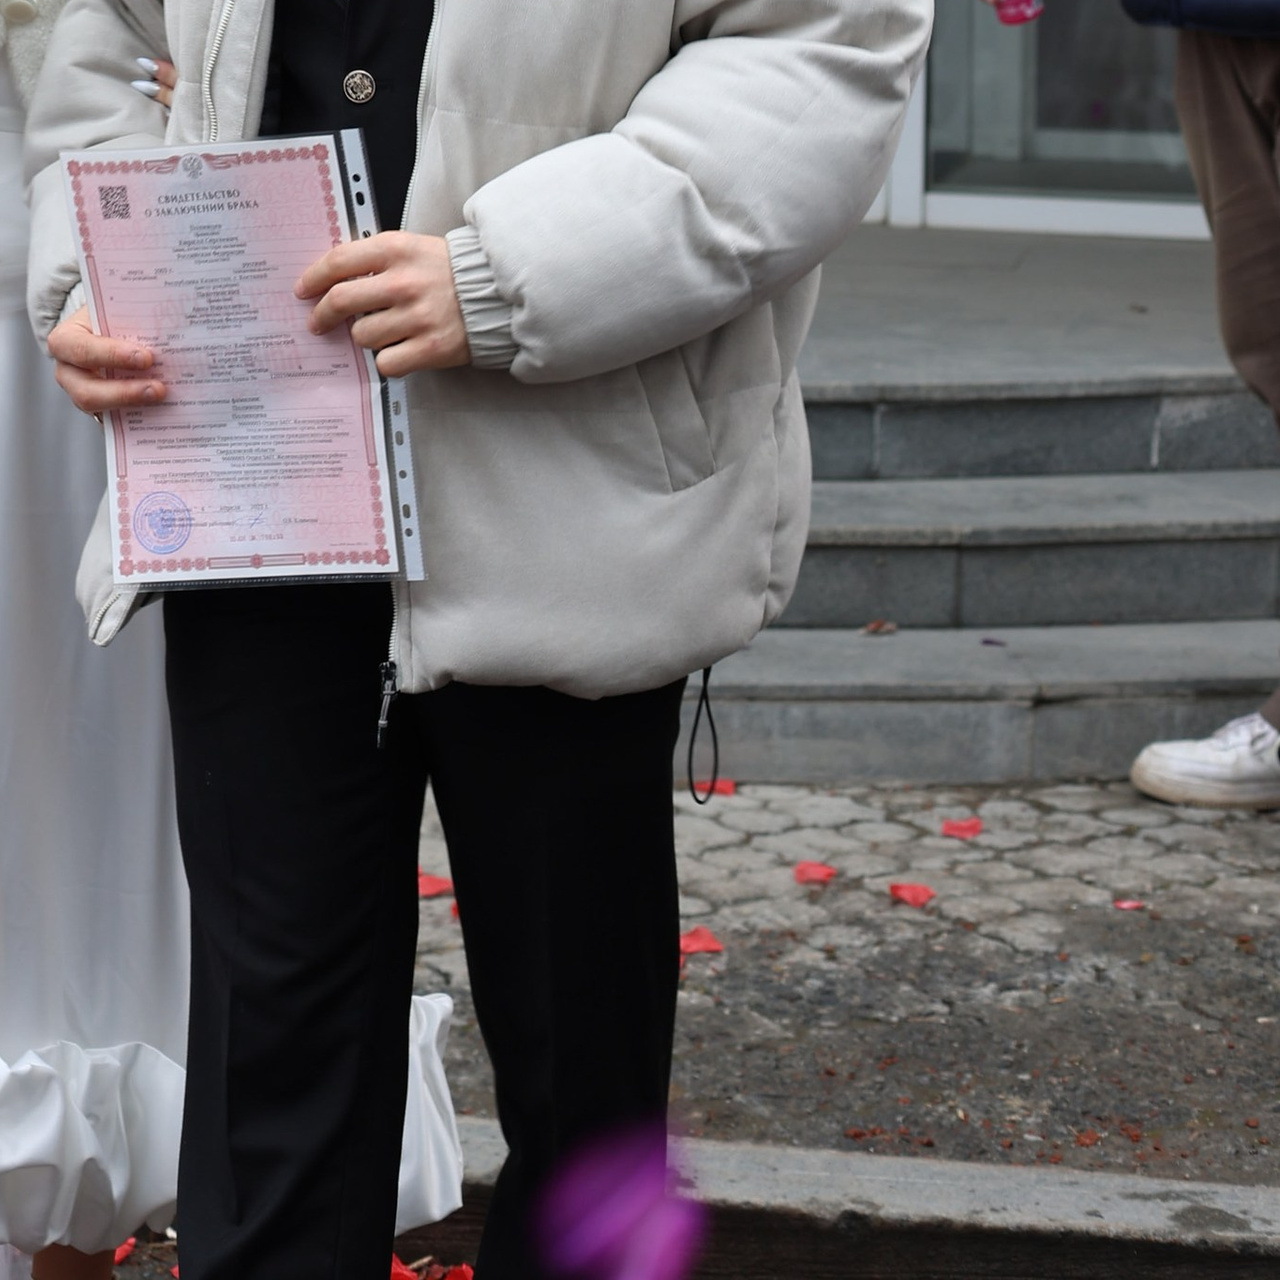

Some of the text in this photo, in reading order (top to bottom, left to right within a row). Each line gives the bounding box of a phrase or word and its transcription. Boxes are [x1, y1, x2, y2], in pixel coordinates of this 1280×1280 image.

[157, 189, 241, 204] СВИДЕТЕЛЬСТВО
[144, 200, 260, 218] О ЗАКЛЮЧЕНИИ БРАКА
